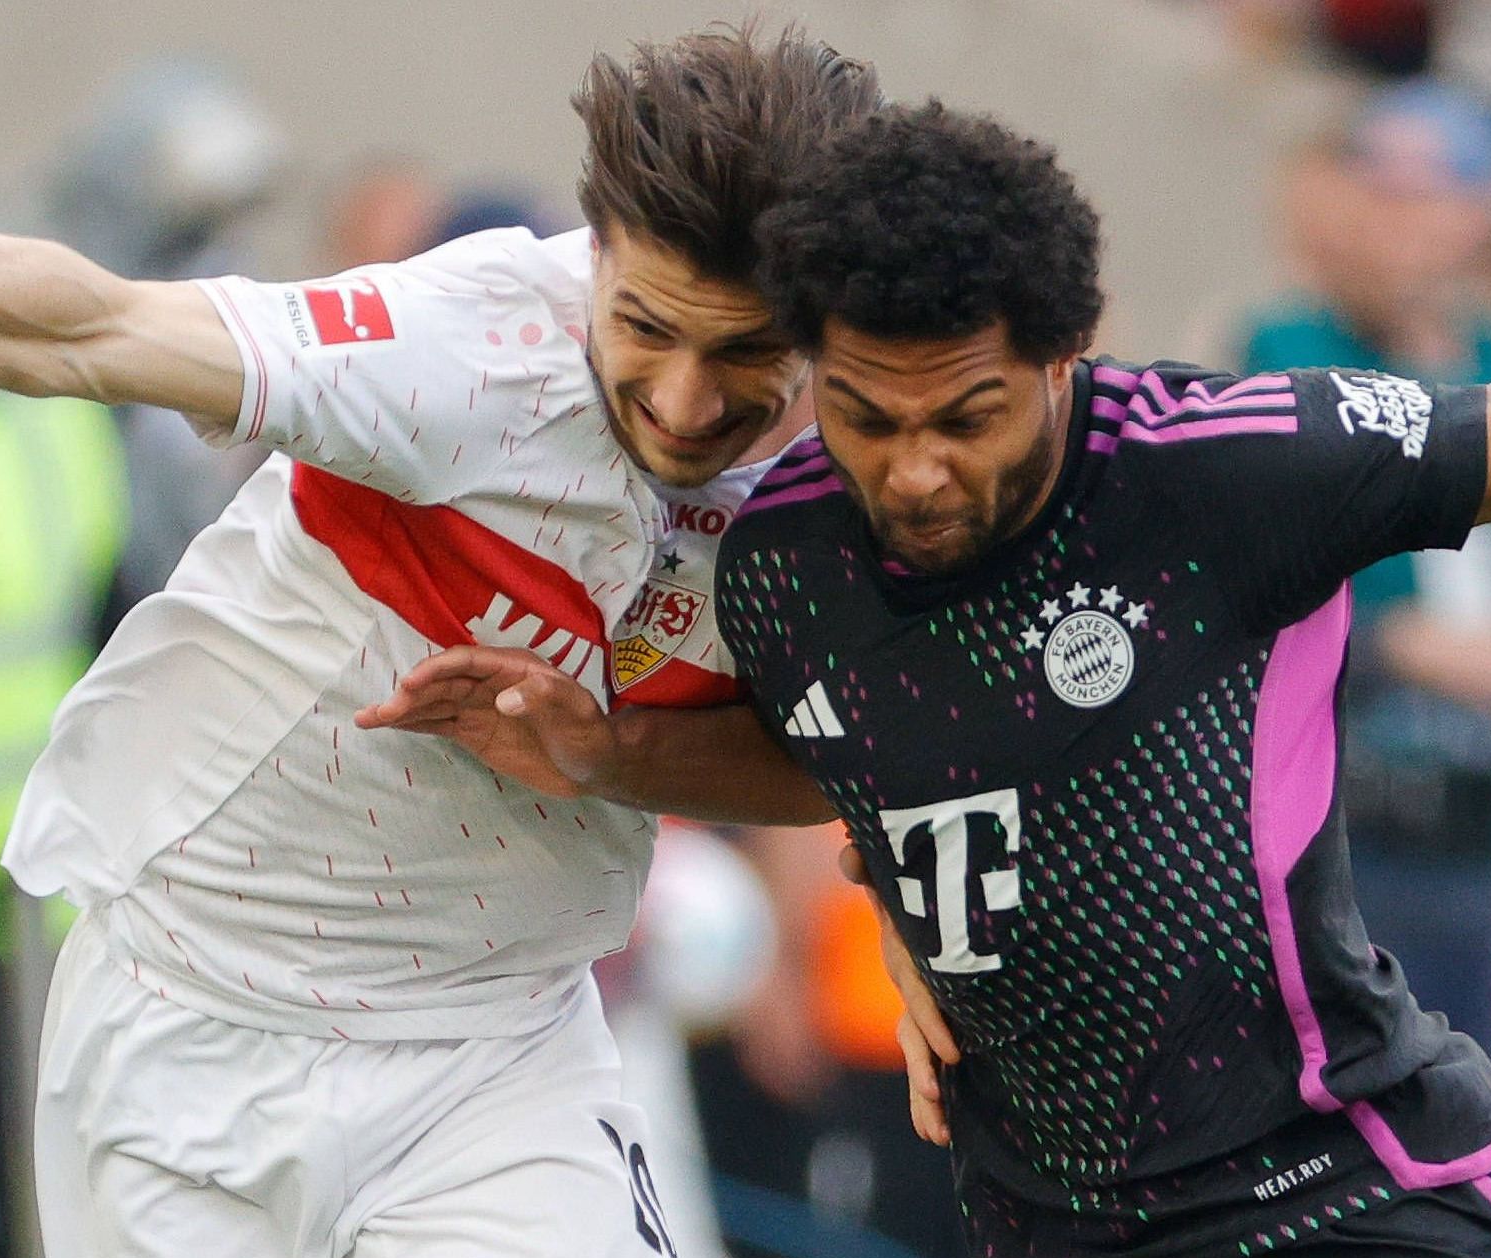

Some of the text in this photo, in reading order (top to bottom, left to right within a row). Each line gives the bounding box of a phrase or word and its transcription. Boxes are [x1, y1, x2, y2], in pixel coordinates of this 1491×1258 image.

[284, 292, 311, 348] DESLIGA
[1065, 618, 1121, 647] BAYERN
[1253, 1153, 1333, 1202] HEAT.RDY
